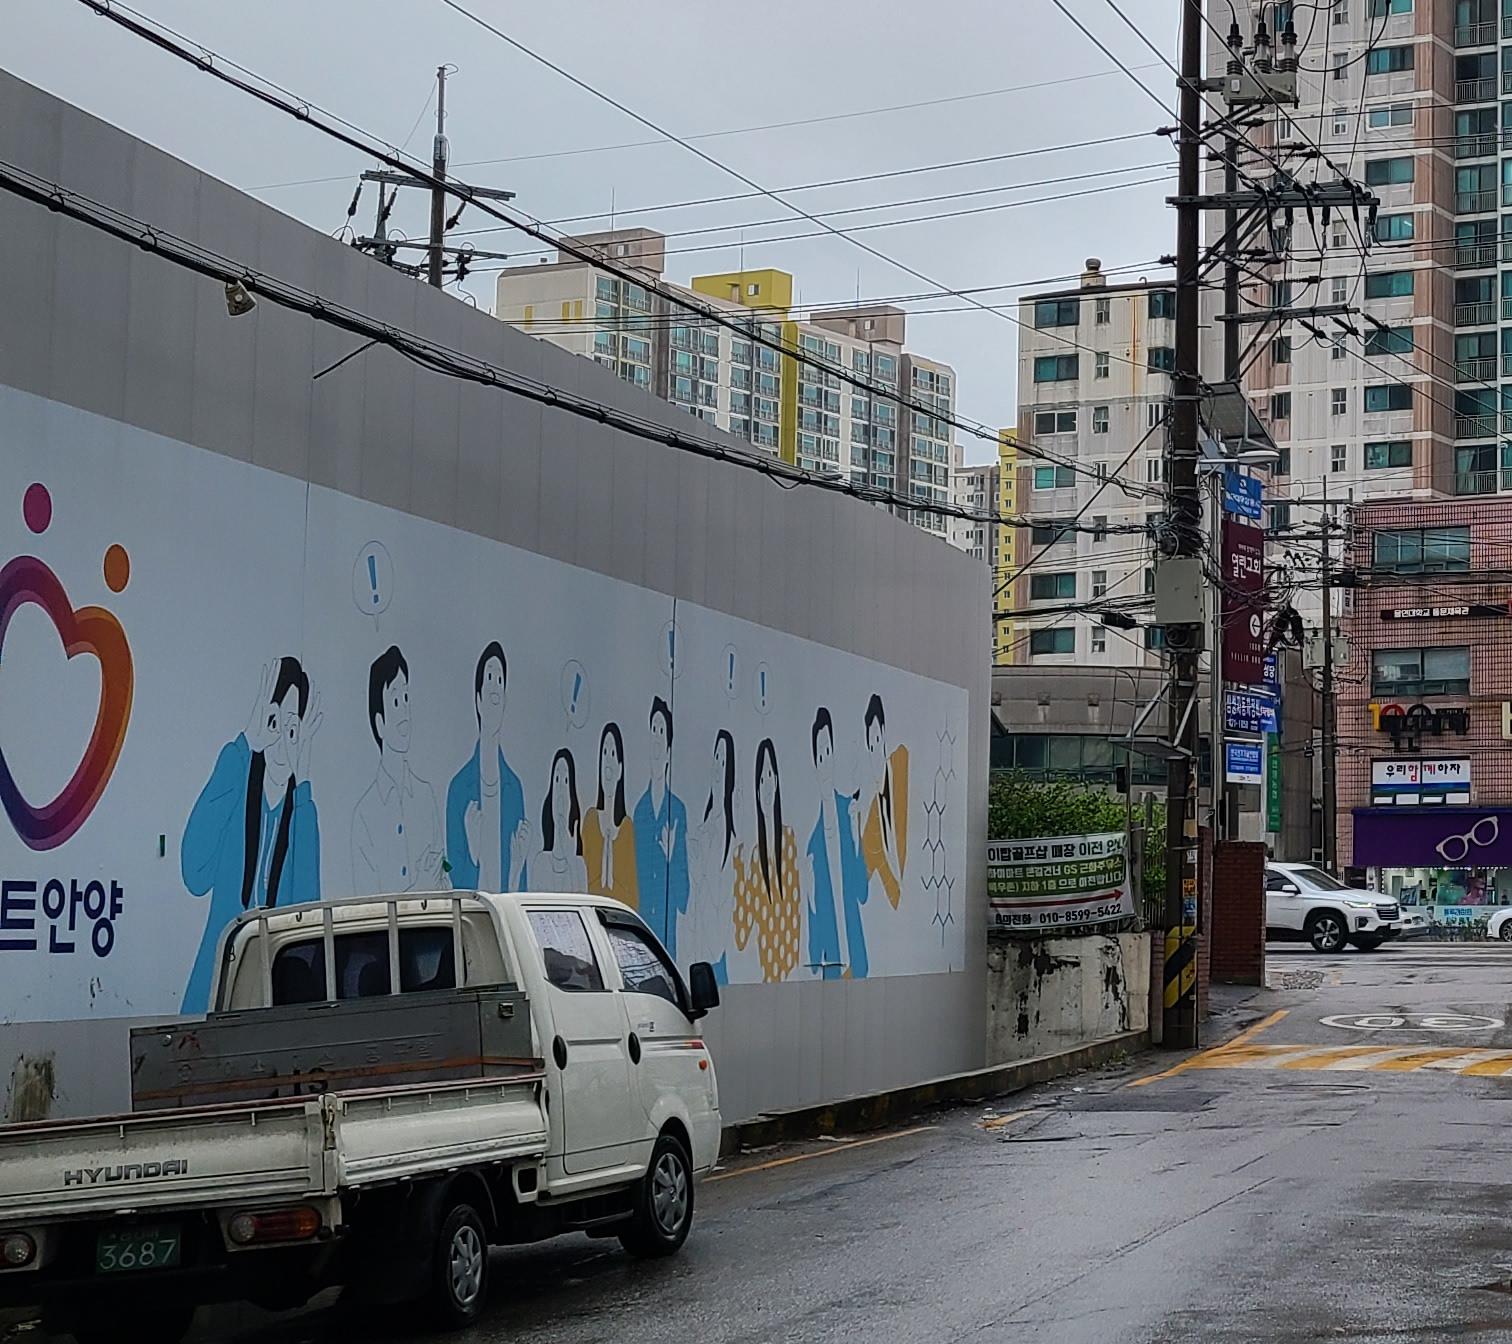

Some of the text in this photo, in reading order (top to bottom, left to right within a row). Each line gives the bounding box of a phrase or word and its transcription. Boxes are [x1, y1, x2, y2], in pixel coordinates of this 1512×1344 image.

[1079, 840, 1103, 856] 이전
[1063, 864, 1078, 875] GS
[1039, 902, 1123, 924] 010-8599-5422
[63, 1158, 189, 1186] HYUNDAI
[99, 1238, 177, 1270] 3687
